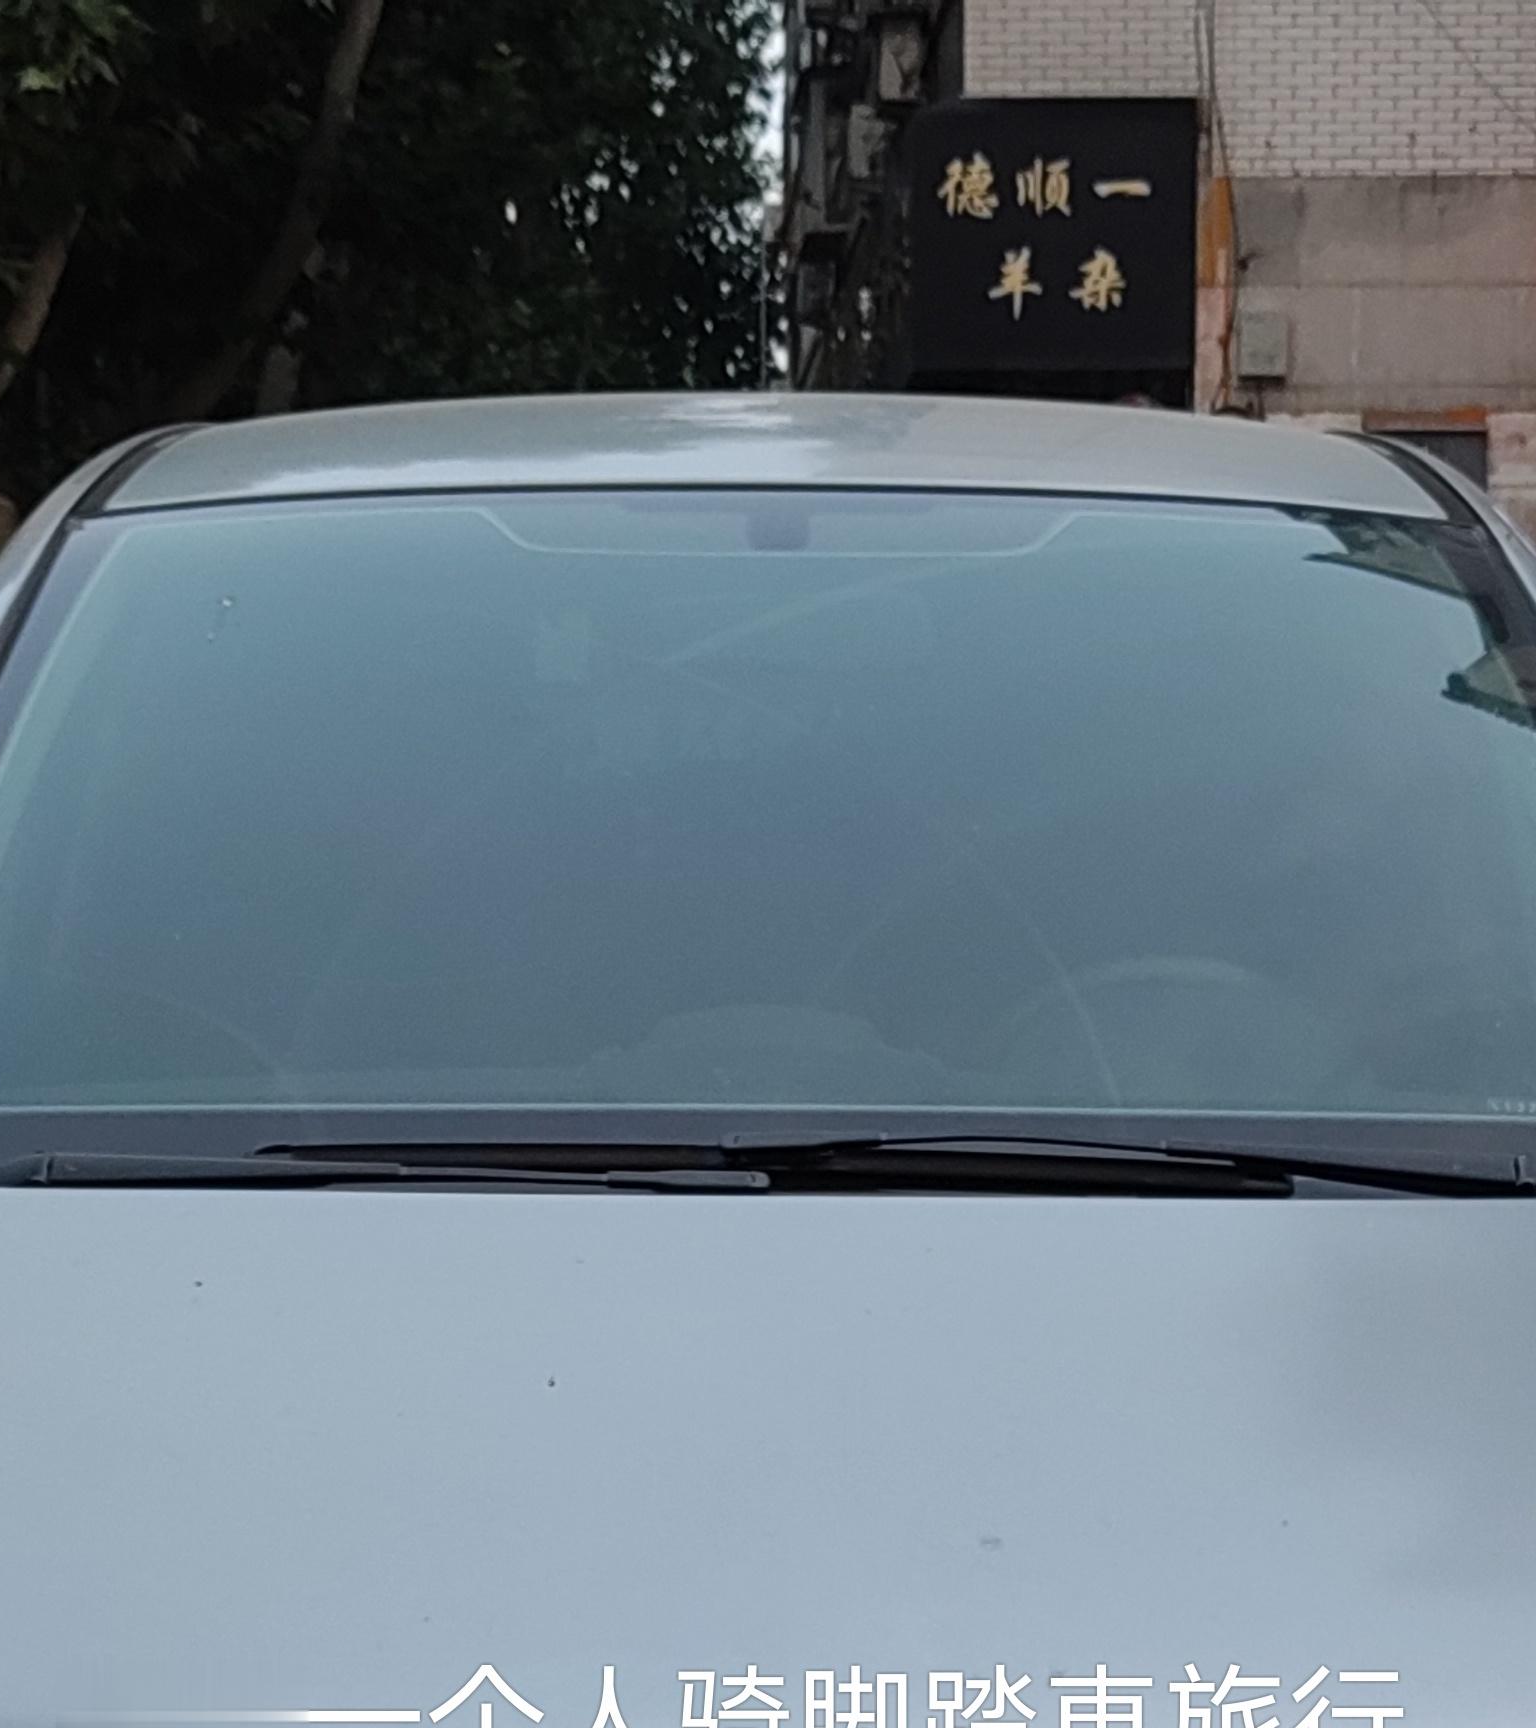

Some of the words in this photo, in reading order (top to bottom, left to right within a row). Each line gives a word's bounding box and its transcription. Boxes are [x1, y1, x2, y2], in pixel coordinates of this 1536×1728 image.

[937, 152, 1152, 219] 德顺一
[988, 246, 1126, 320] 羊杂
